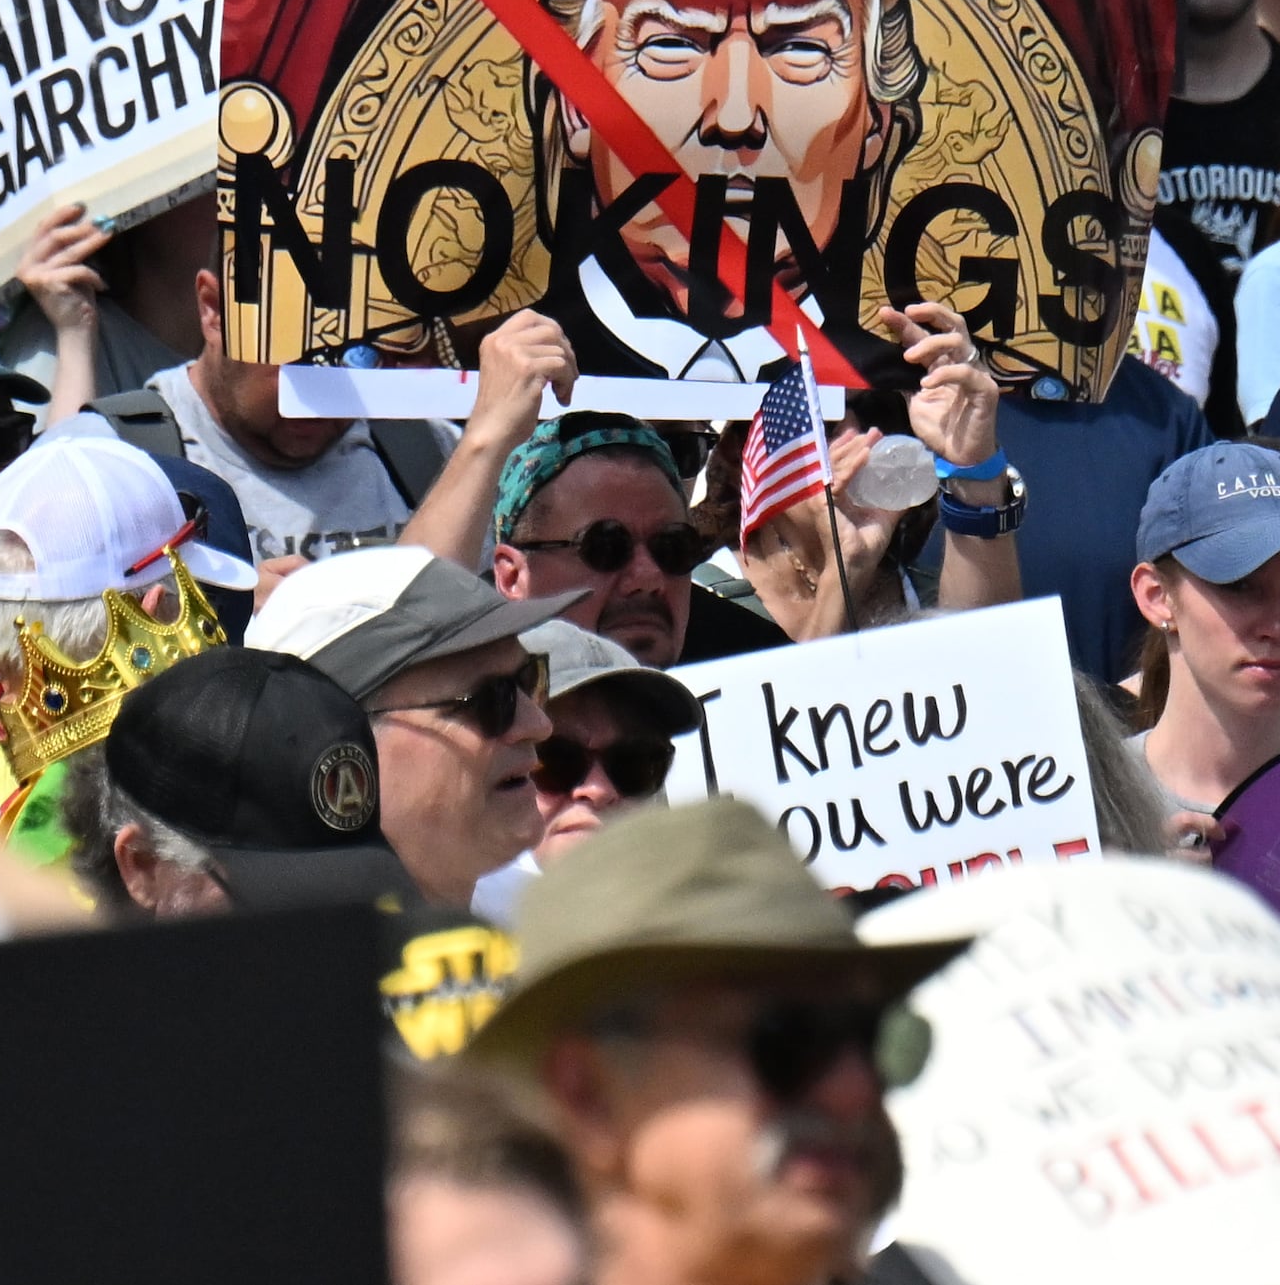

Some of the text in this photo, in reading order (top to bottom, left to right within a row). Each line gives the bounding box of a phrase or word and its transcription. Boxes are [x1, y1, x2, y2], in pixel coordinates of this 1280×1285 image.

[233, 151, 1123, 350] NO KINGS
[760, 681, 969, 785] knew
[899, 750, 1076, 834] were
